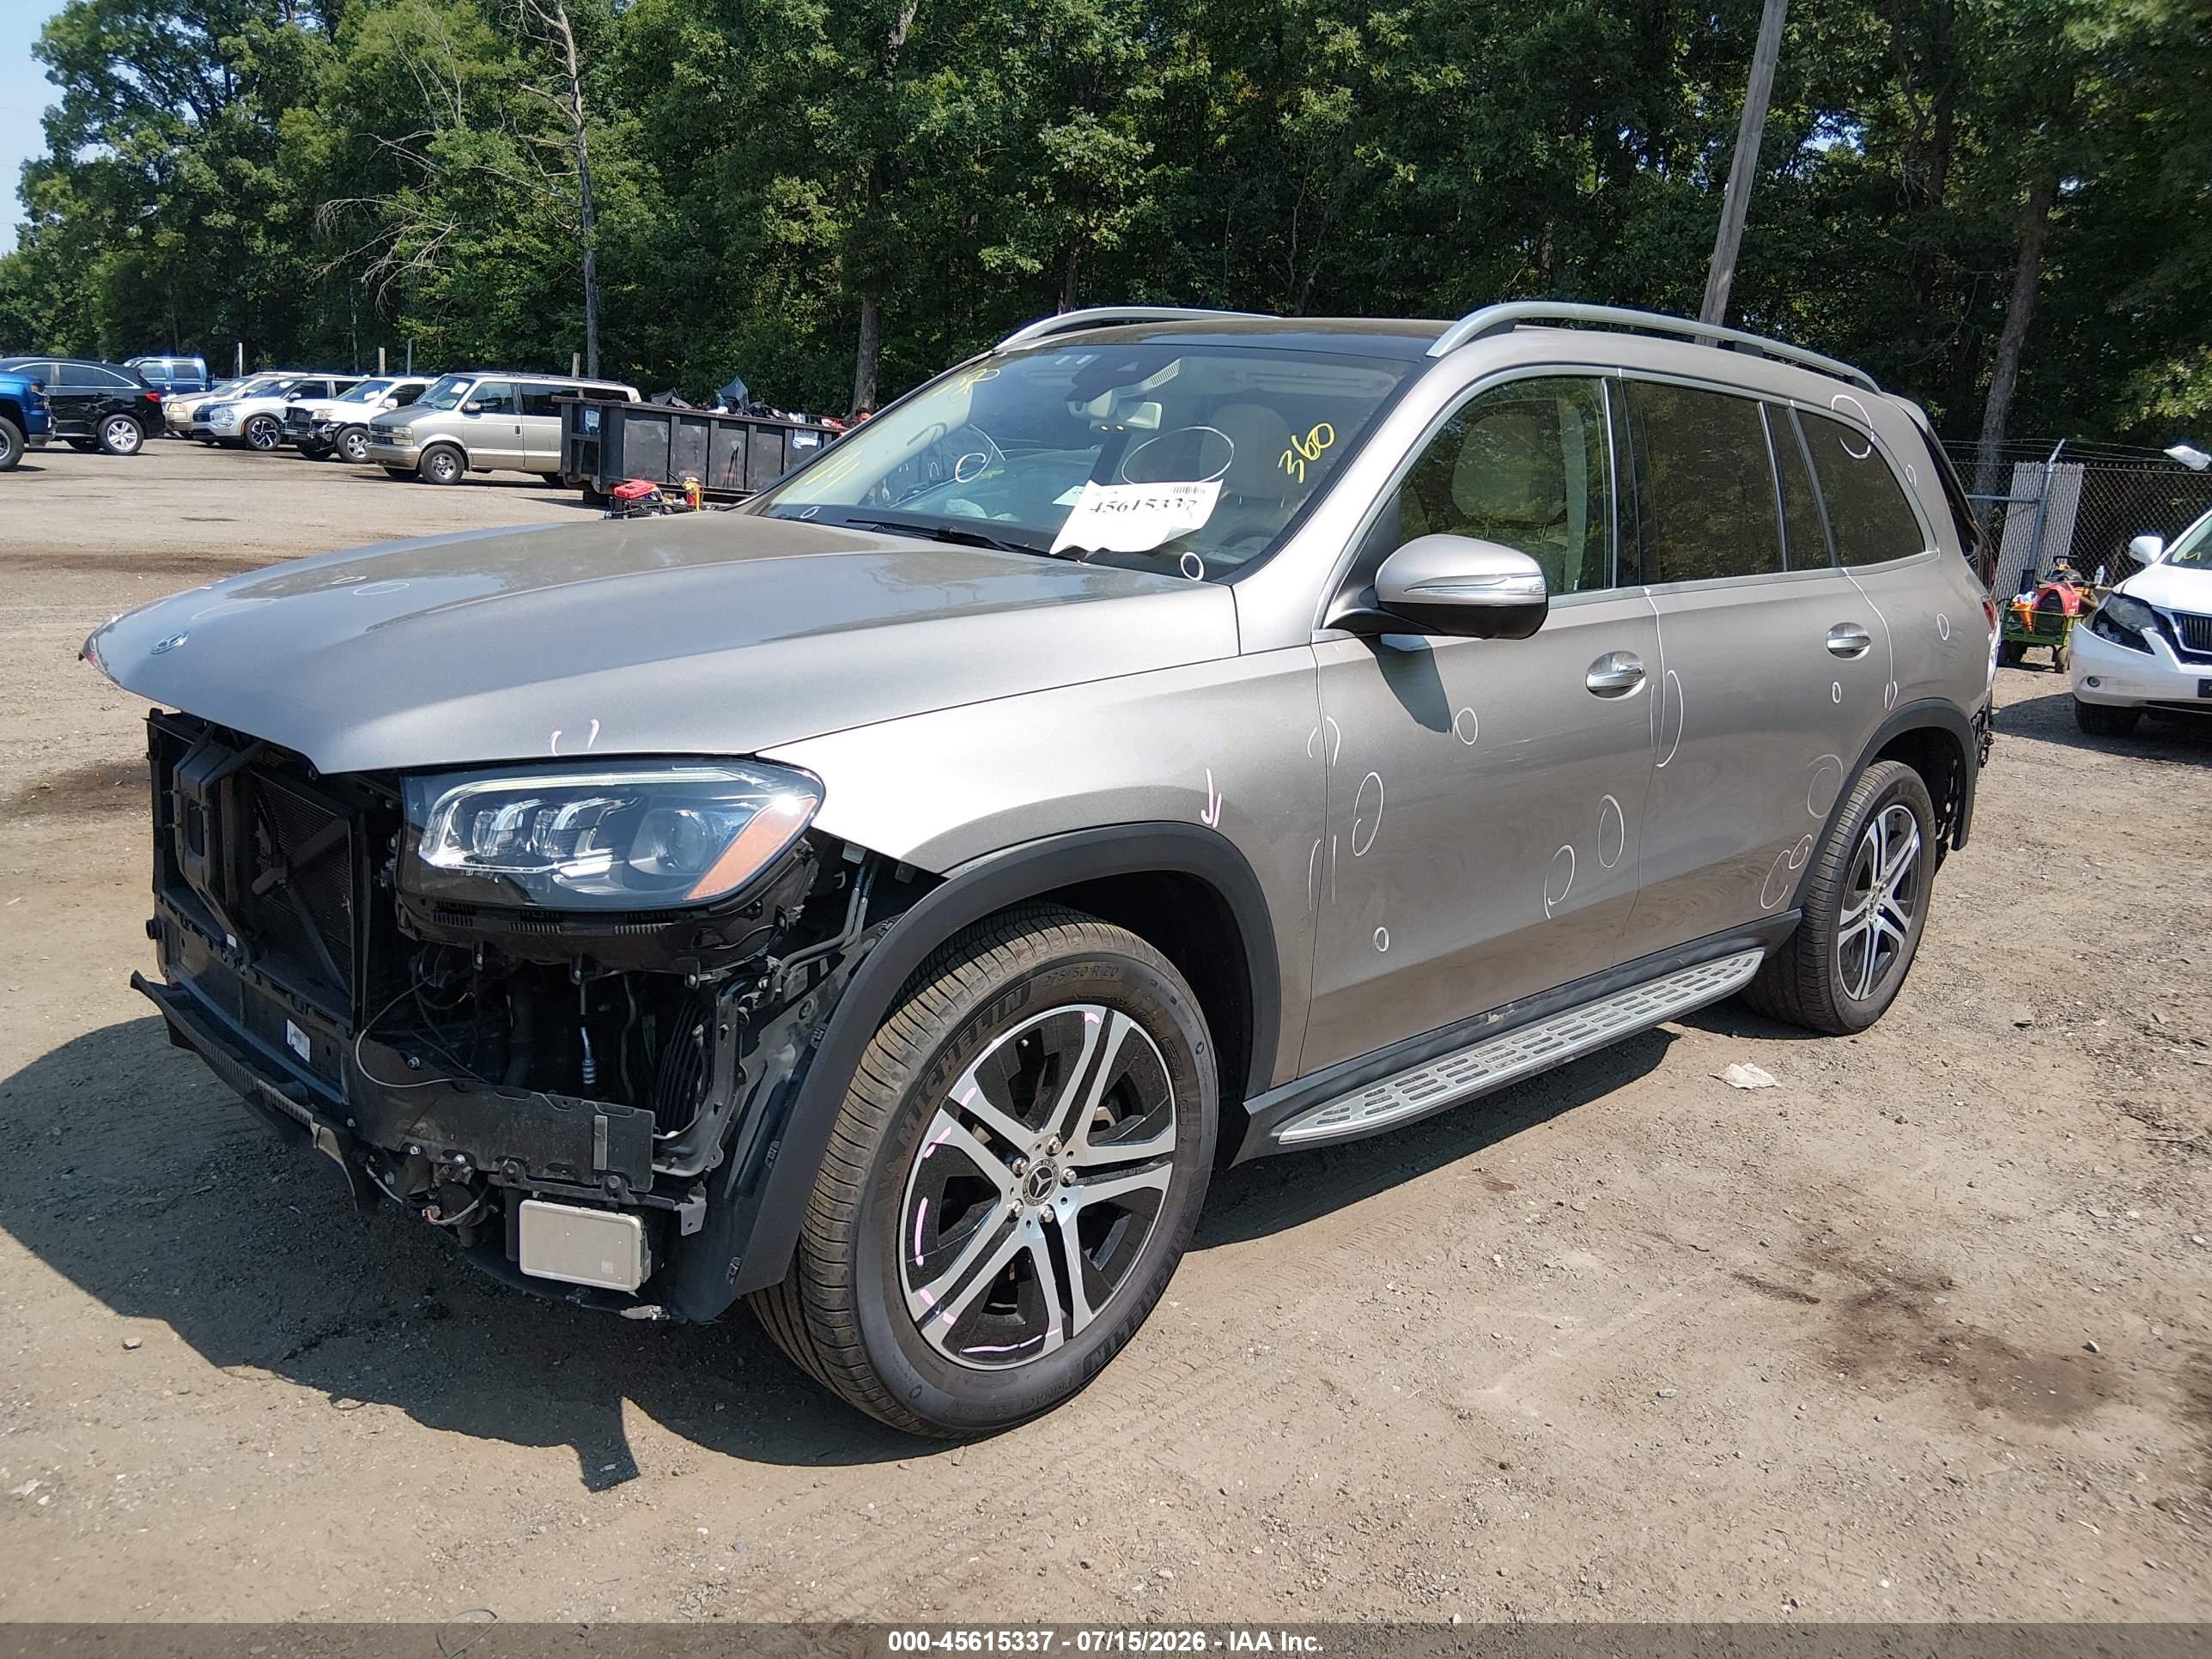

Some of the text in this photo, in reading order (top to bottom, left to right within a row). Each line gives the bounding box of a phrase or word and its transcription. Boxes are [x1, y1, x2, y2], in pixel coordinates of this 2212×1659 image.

[1277, 422, 1336, 483] 360
[1089, 497, 1198, 514] 45615337
[898, 988, 1024, 1147] MICHELIN
